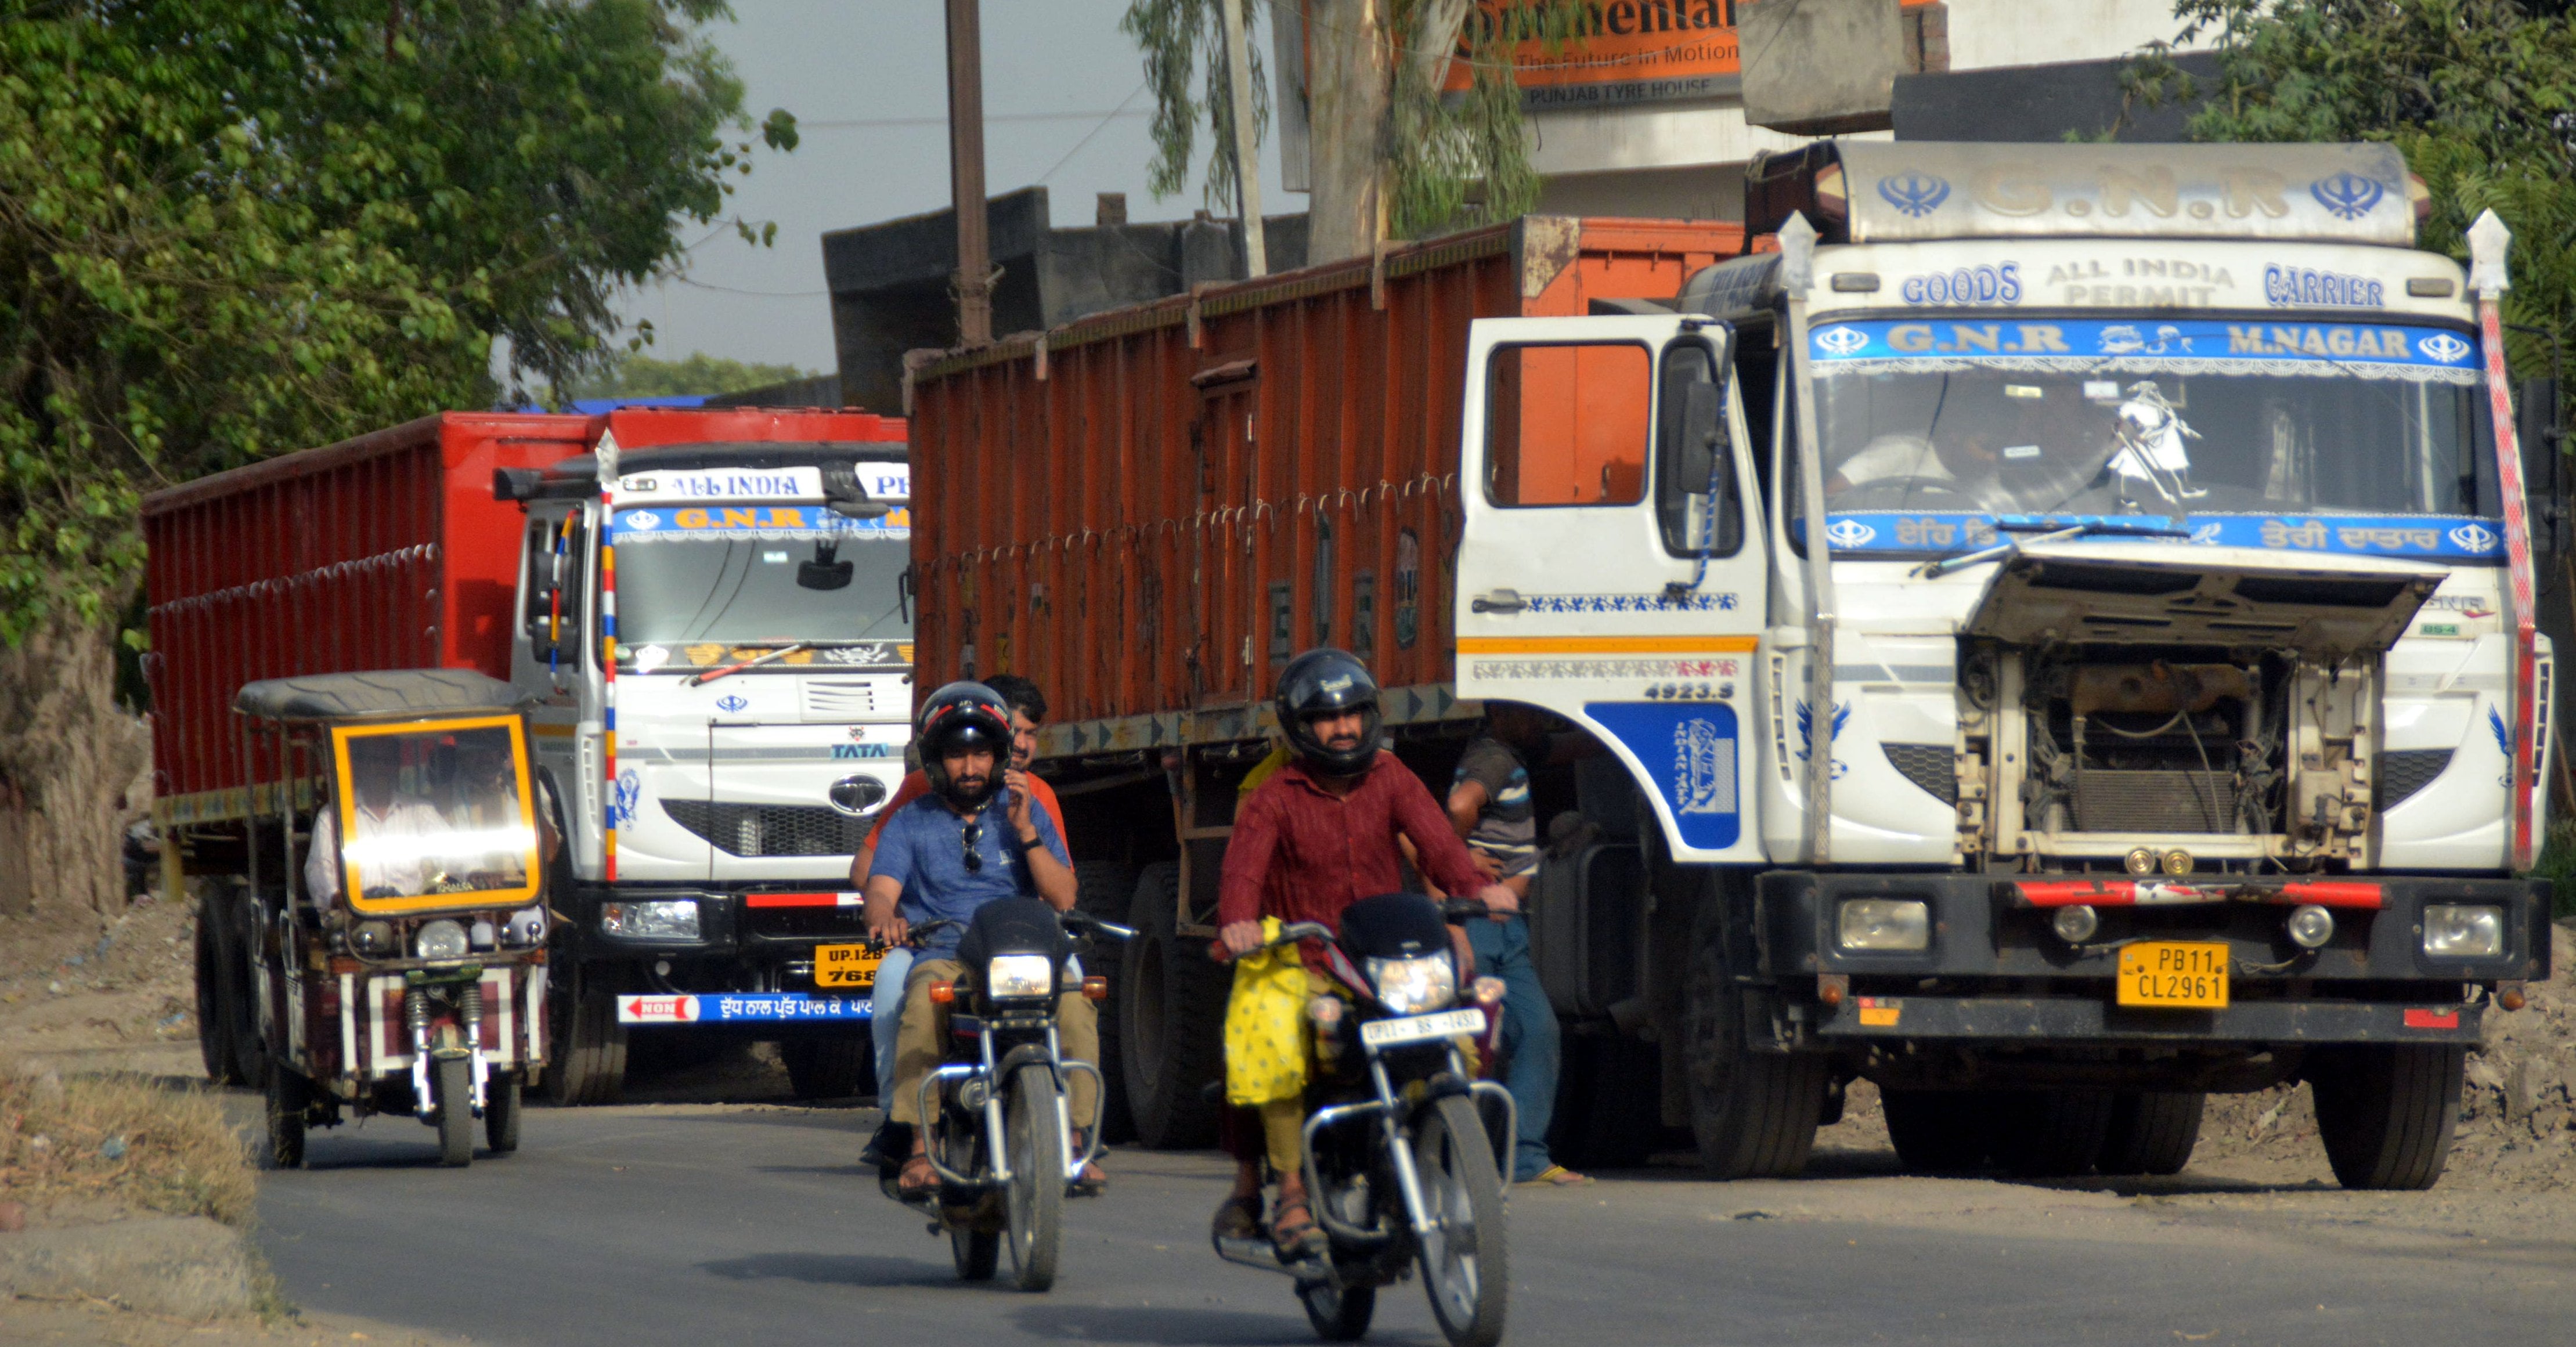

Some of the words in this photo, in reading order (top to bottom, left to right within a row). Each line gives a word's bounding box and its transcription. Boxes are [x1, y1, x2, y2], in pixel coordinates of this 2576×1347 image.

[1517, 54, 1555, 71] The
[1564, 51, 1632, 70] Future
[1638, 48, 1658, 65] in
[1665, 42, 1739, 64] Motion
[1530, 85, 1599, 104] PUNJAB
[1604, 81, 1646, 100] TYRE
[1651, 79, 1711, 97] HOUSE
[1969, 164, 2290, 218] G.N.R
[1901, 260, 2023, 306] GOODS
[2046, 259, 2110, 286] ALL
[2123, 258, 2235, 289] INDIA
[2264, 262, 2384, 307] CARRIER
[2064, 285, 2216, 306] PERMIT
[1886, 324, 2069, 352] G.N.R
[2227, 325, 2411, 358] M.NAGAR
[672, 476, 721, 496] ALL
[727, 476, 800, 496] INDIA
[675, 508, 806, 529] G.N.R
[832, 743, 887, 757] TATA
[2159, 948, 2212, 973] PB11
[2139, 974, 2219, 999] CL2961
[720, 996, 744, 1018] ਦੁੱਧ
[745, 1000, 773, 1014] ਨਾਲ
[774, 996, 797, 1018] ਪੁੱਤ
[799, 1000, 826, 1015] ਪਾਲ
